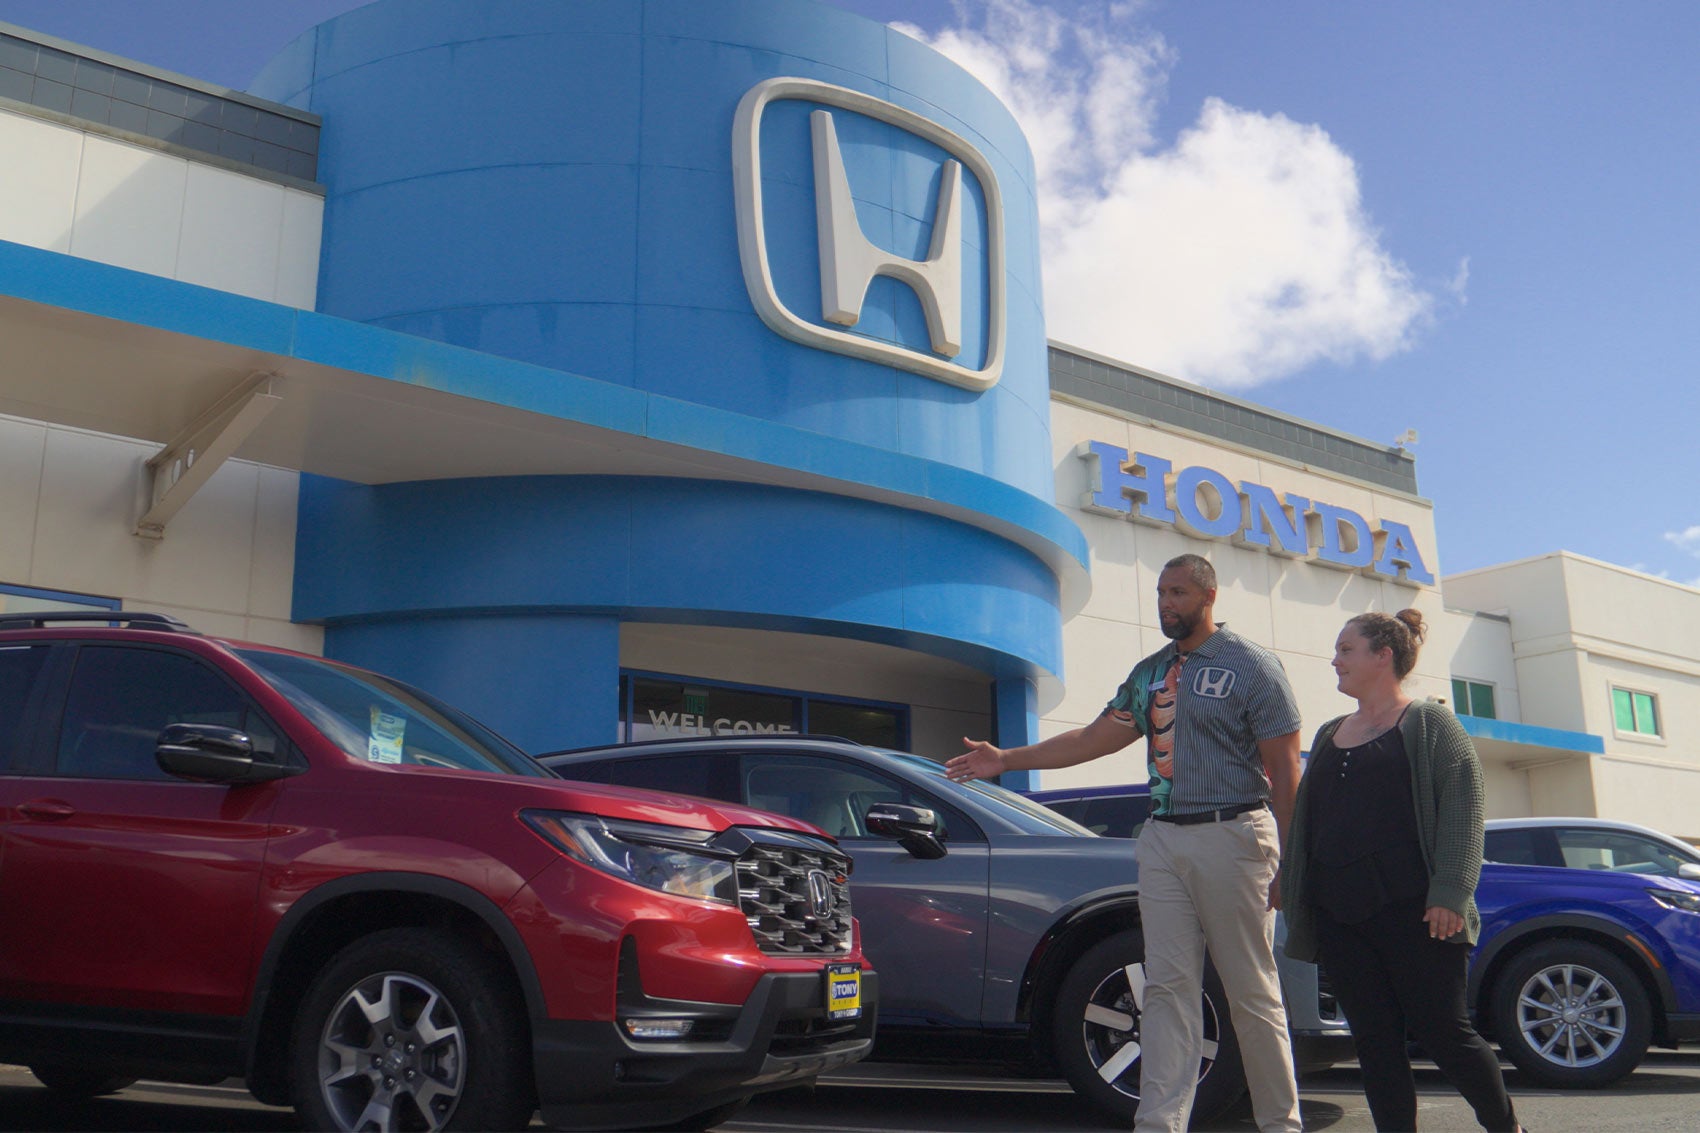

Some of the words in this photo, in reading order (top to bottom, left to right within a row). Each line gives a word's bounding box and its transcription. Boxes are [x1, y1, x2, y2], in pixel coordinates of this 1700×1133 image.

[1080, 439, 1435, 587] HONDA
[648, 709, 792, 735] WELCOME
[836, 983, 857, 995] TONY
